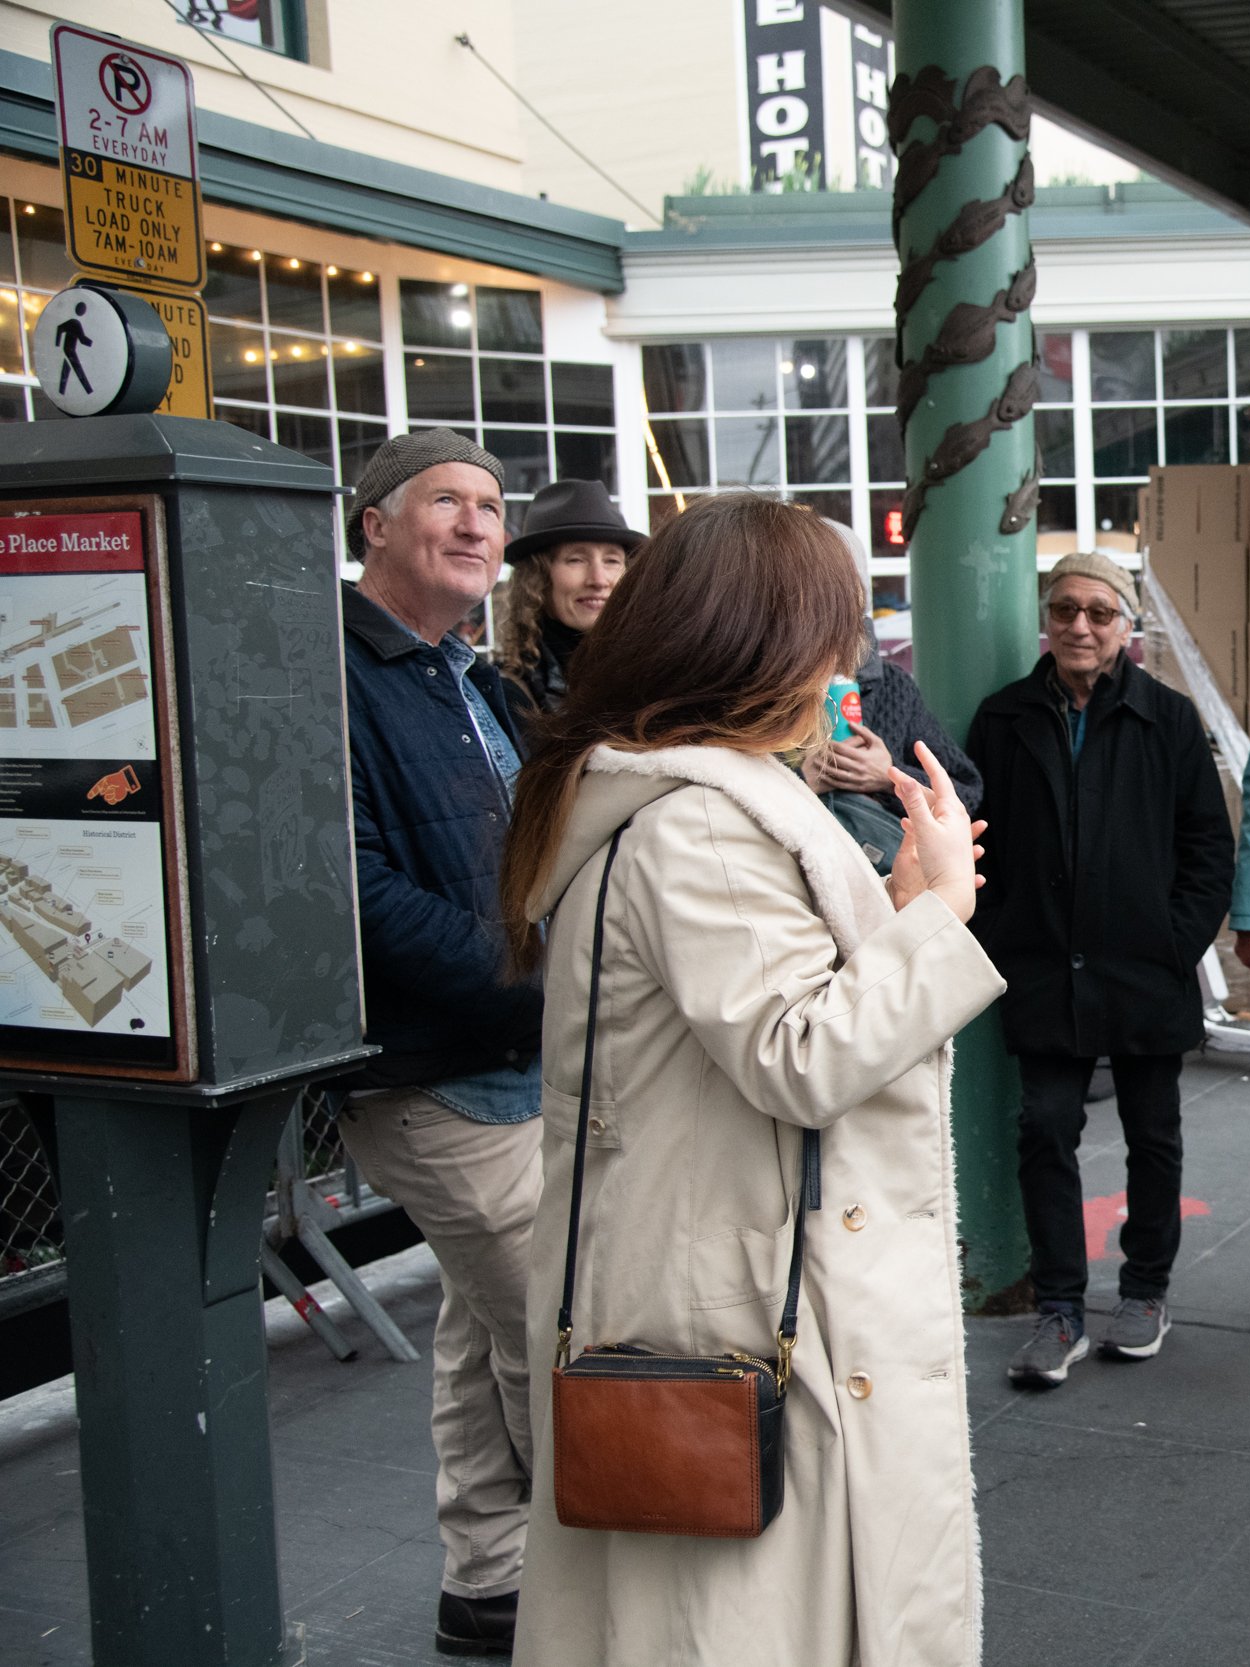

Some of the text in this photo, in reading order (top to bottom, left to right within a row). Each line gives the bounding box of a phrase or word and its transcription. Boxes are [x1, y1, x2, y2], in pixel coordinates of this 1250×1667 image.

[88, 108, 168, 149] 2-7 AM
[755, 50, 809, 188] HOT
[93, 135, 167, 167] EVERYDAY
[71, 152, 183, 199] 30 MINUTE
[104, 187, 166, 219] TRUCK
[85, 205, 181, 244] LOAD ONLY
[93, 229, 178, 265] 7AM-10AM
[114, 256, 165, 274] EVEDAY
[151, 301, 197, 326] NUTE
[169, 335, 191, 359] ND
[8, 533, 58, 554] Place
[60, 531, 131, 552] Market
[82, 829, 137, 839] Historical District
